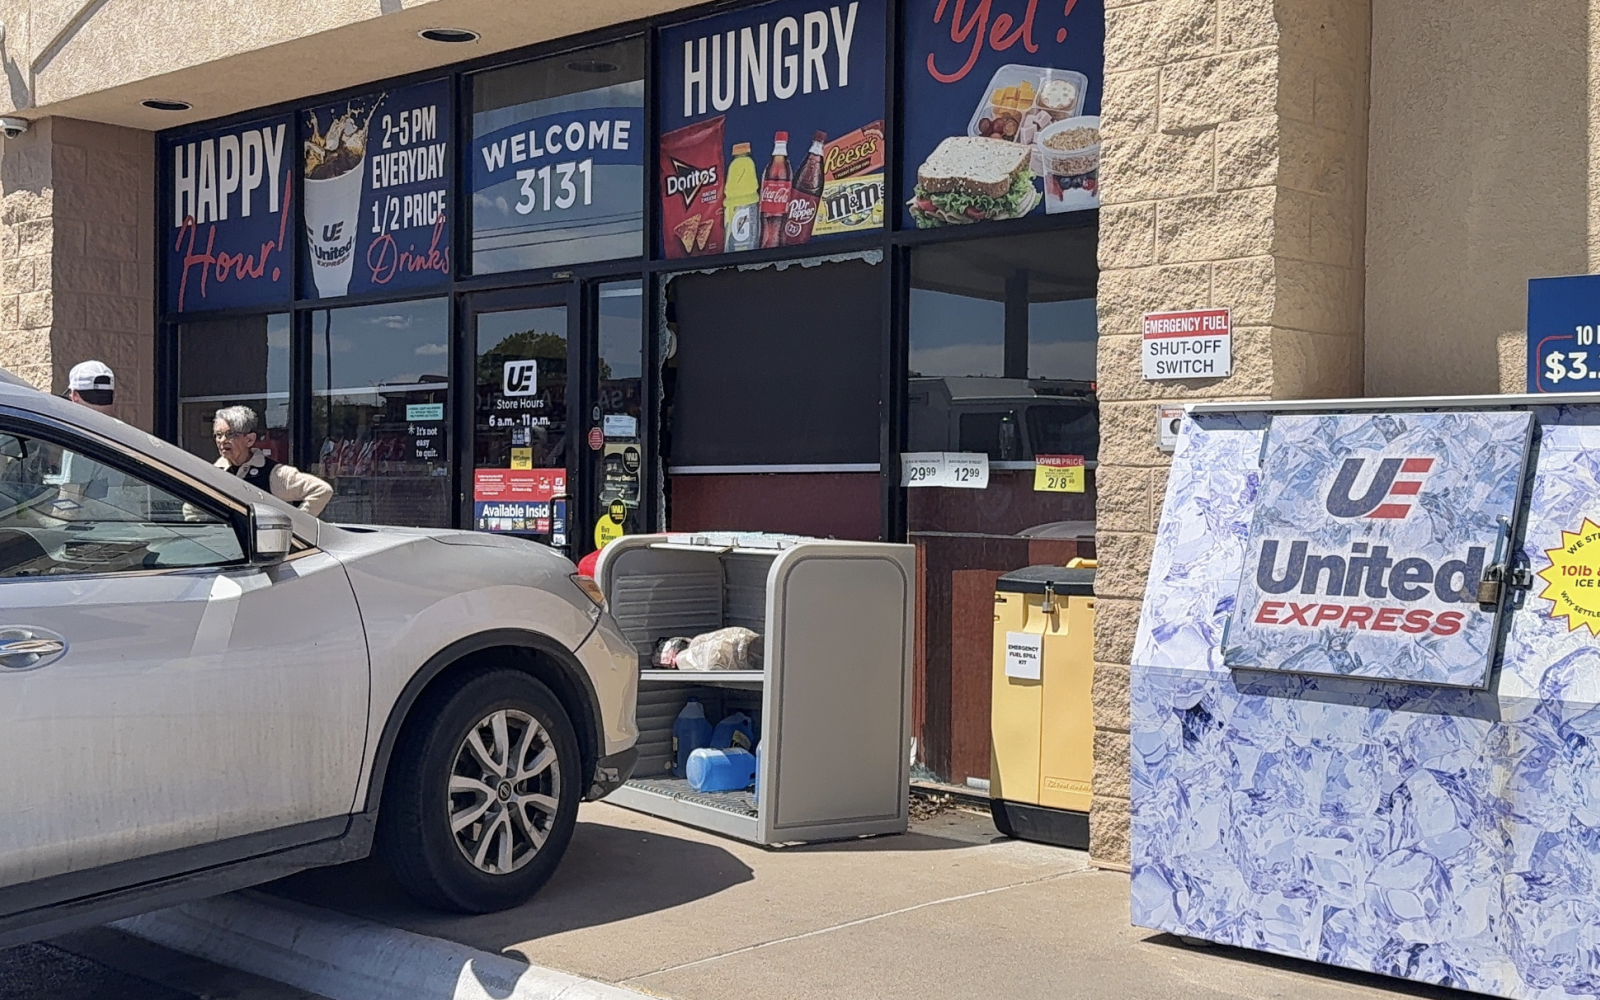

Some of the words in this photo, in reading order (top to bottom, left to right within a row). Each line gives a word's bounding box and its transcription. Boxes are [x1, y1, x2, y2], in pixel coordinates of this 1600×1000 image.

[927, 0, 1078, 83] Yet
[684, 1, 859, 118] HUNGRY
[382, 111, 409, 149] 2-5
[412, 105, 436, 143] PM
[481, 120, 631, 173] WELCOME
[824, 138, 877, 174] Reese's
[175, 124, 286, 228] HAPPY
[372, 143, 447, 189] EVERYDAY
[515, 158, 593, 215] 3131
[667, 166, 717, 195] Doritos
[372, 195, 400, 236] 1/2
[403, 190, 446, 229] PRICE
[789, 199, 815, 220] Pepper
[175, 170, 291, 313] Hour!
[314, 235, 353, 261] United
[367, 213, 450, 284] Drinks
[1144, 317, 1201, 335] EMERGENCY
[1203, 315, 1228, 331] FUEL
[1576, 325, 1593, 345] 10
[1150, 339, 1222, 356] SHUT-OFF
[1156, 359, 1214, 374] SWITCH
[1545, 351, 1600, 383] $3.
[497, 399, 518, 410] Store
[520, 398, 544, 409] Hours
[489, 415, 495, 427] 6
[497, 417, 515, 427] a.m.
[522, 413, 530, 426] 11
[532, 416, 550, 428] p.m.
[416, 426, 426, 436] It's
[427, 427, 438, 436] not
[416, 439, 430, 449] easy
[416, 449, 423, 458] to
[423, 448, 438, 460] quit.
[1036, 457, 1061, 465] LOWER
[482, 503, 524, 517] Available
[526, 504, 557, 518] Insid!
[601, 525, 610, 534] Buy
[1567, 540, 1584, 555] WE
[1256, 539, 1486, 604] United
[1561, 565, 1592, 576] 10lb
[1575, 579, 1594, 587] ICE
[1561, 590, 1575, 607] WHY
[1254, 601, 1466, 636] EXPRESS
[1008, 644, 1039, 652] EMERGENCY
